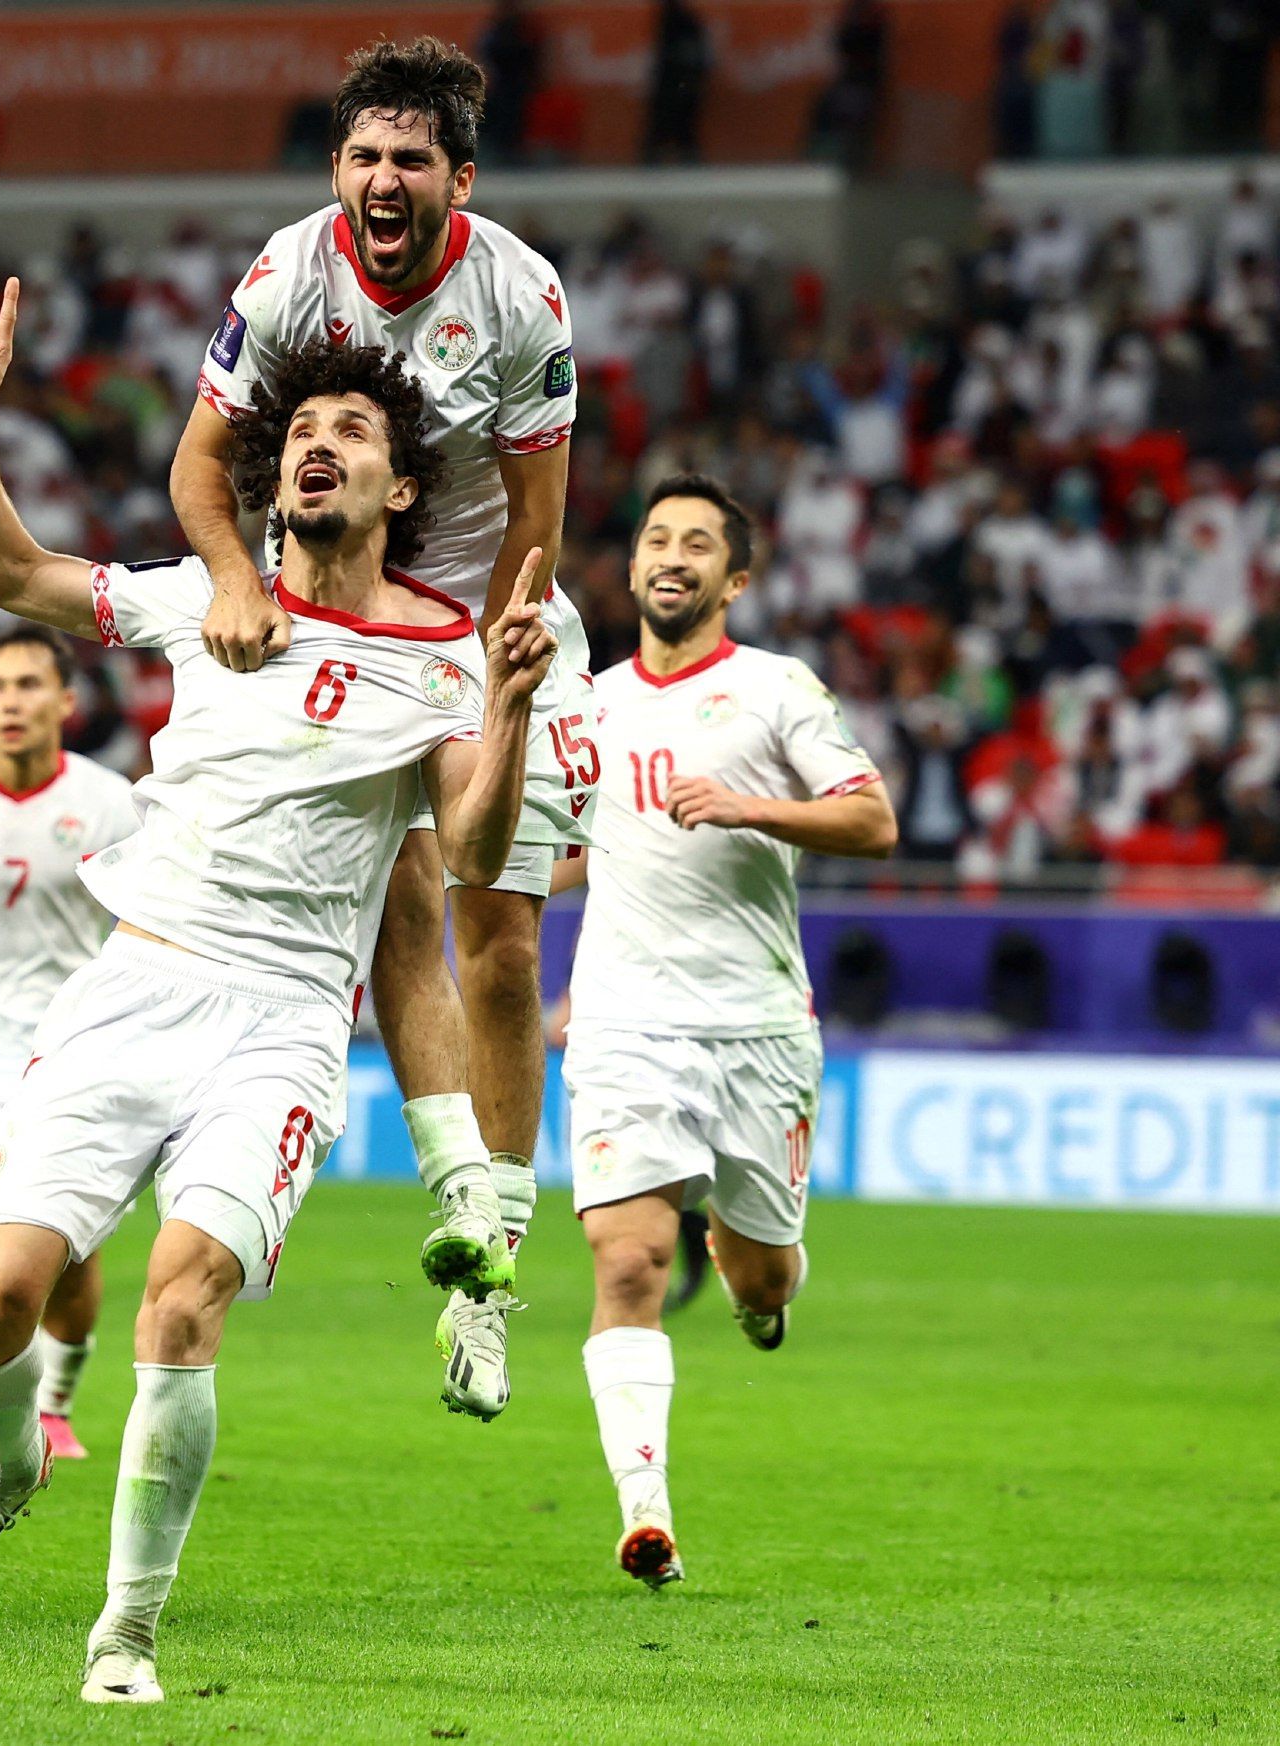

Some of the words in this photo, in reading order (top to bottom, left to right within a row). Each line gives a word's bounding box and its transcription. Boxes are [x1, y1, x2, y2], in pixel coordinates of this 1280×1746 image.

[553, 353, 569, 366] AFC
[304, 659, 357, 722] 6
[548, 713, 601, 789] 15
[628, 747, 674, 813] 10
[4, 856, 29, 909] 7
[785, 1115, 810, 1188] 10
[890, 1081, 1280, 1199] CREDIT
